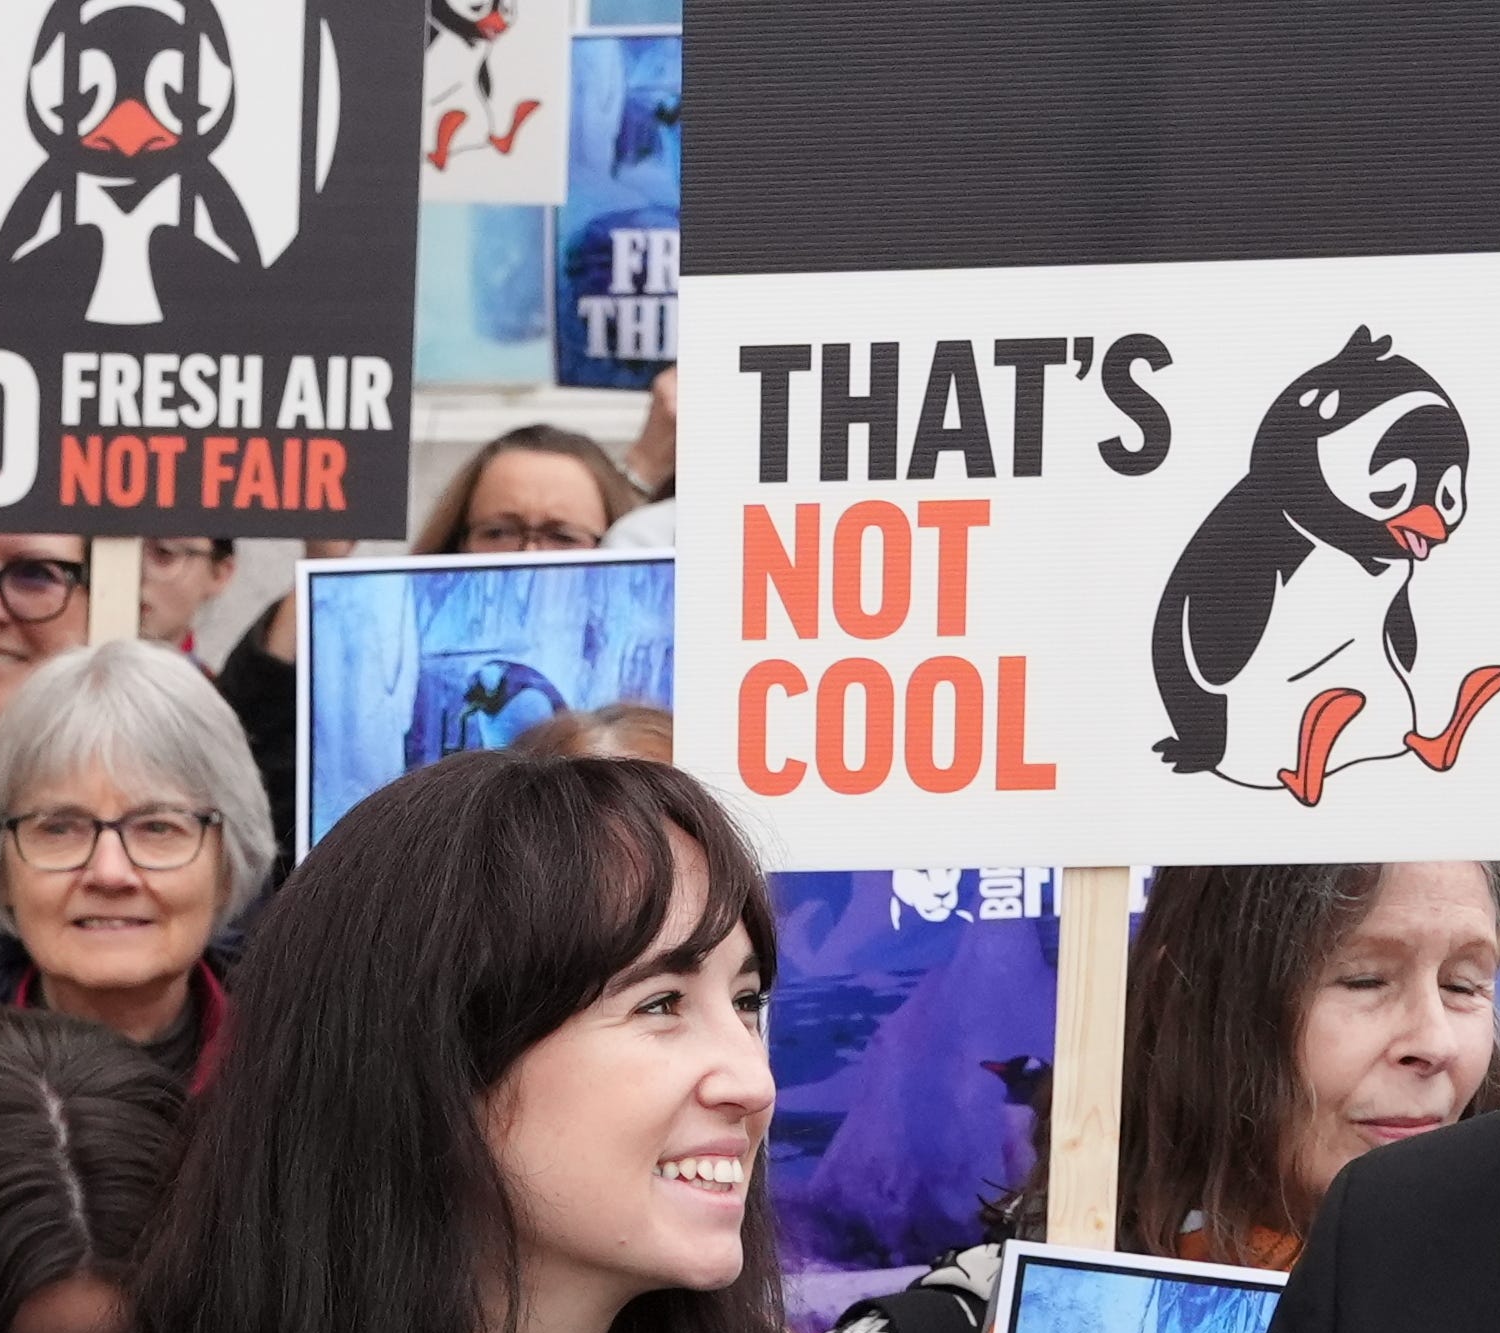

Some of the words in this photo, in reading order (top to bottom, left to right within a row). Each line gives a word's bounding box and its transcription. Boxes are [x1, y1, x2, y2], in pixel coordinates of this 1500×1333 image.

[61, 352, 264, 430] FRESH
[276, 354, 394, 432] AIR
[739, 333, 1174, 483] THAT'S
[59, 434, 187, 508] NOT
[202, 436, 348, 511] FAIR
[741, 499, 991, 641] NOT
[737, 656, 1057, 797] COOL
[978, 866, 1023, 920] BO
